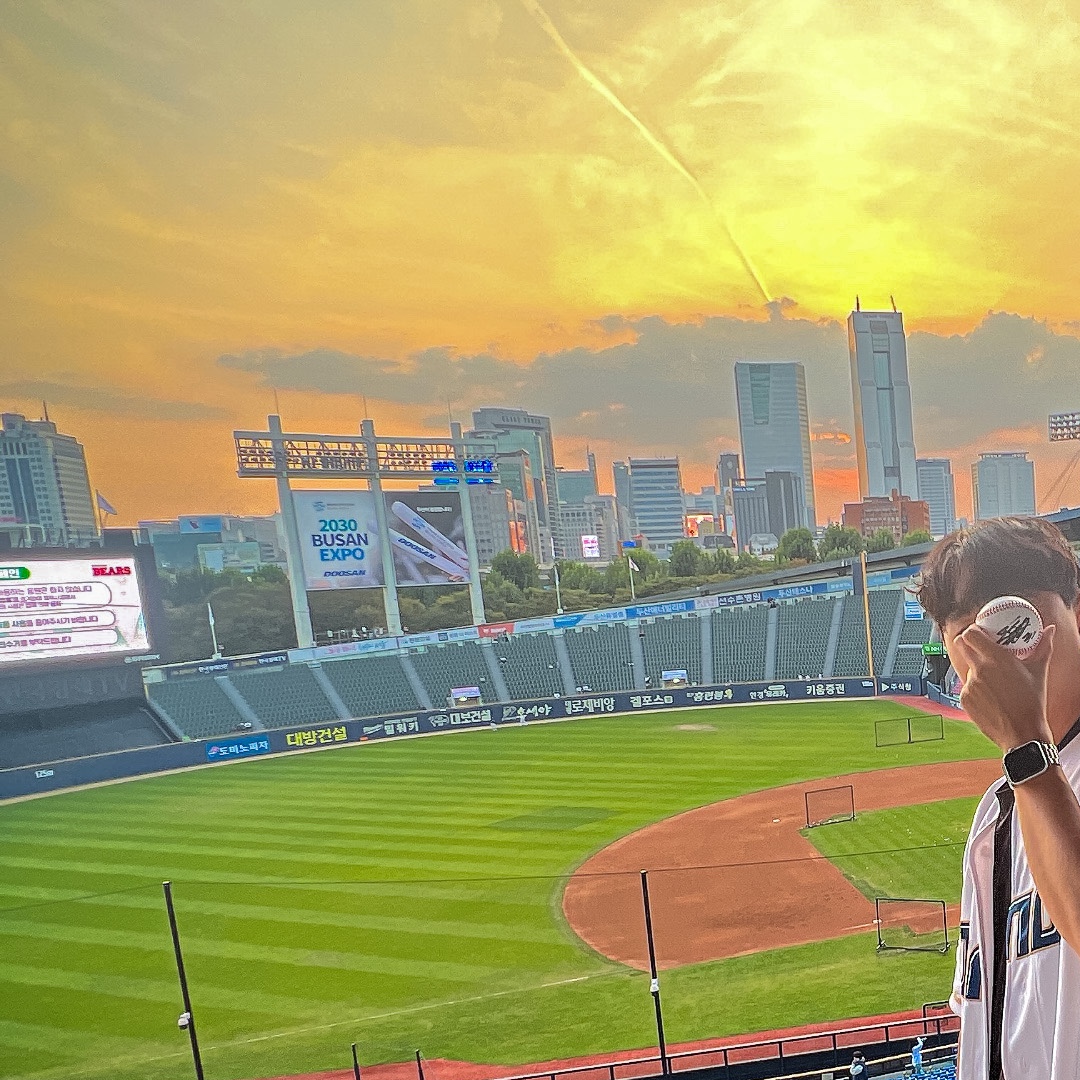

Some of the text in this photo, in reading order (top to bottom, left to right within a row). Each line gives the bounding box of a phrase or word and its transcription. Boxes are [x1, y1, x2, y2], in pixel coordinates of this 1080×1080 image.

[319, 519, 358, 532] 2030
[312, 533, 369, 547] BUSAN
[320, 548, 365, 562] EXPO
[397, 537, 437, 560] DOOSAN
[92, 566, 131, 577] BEARS
[323, 569, 367, 577] DOOSAN
[806, 683, 845, 696] 키움증권
[285, 726, 348, 747] 대방건설
[218, 741, 269, 756] 도미노피자
